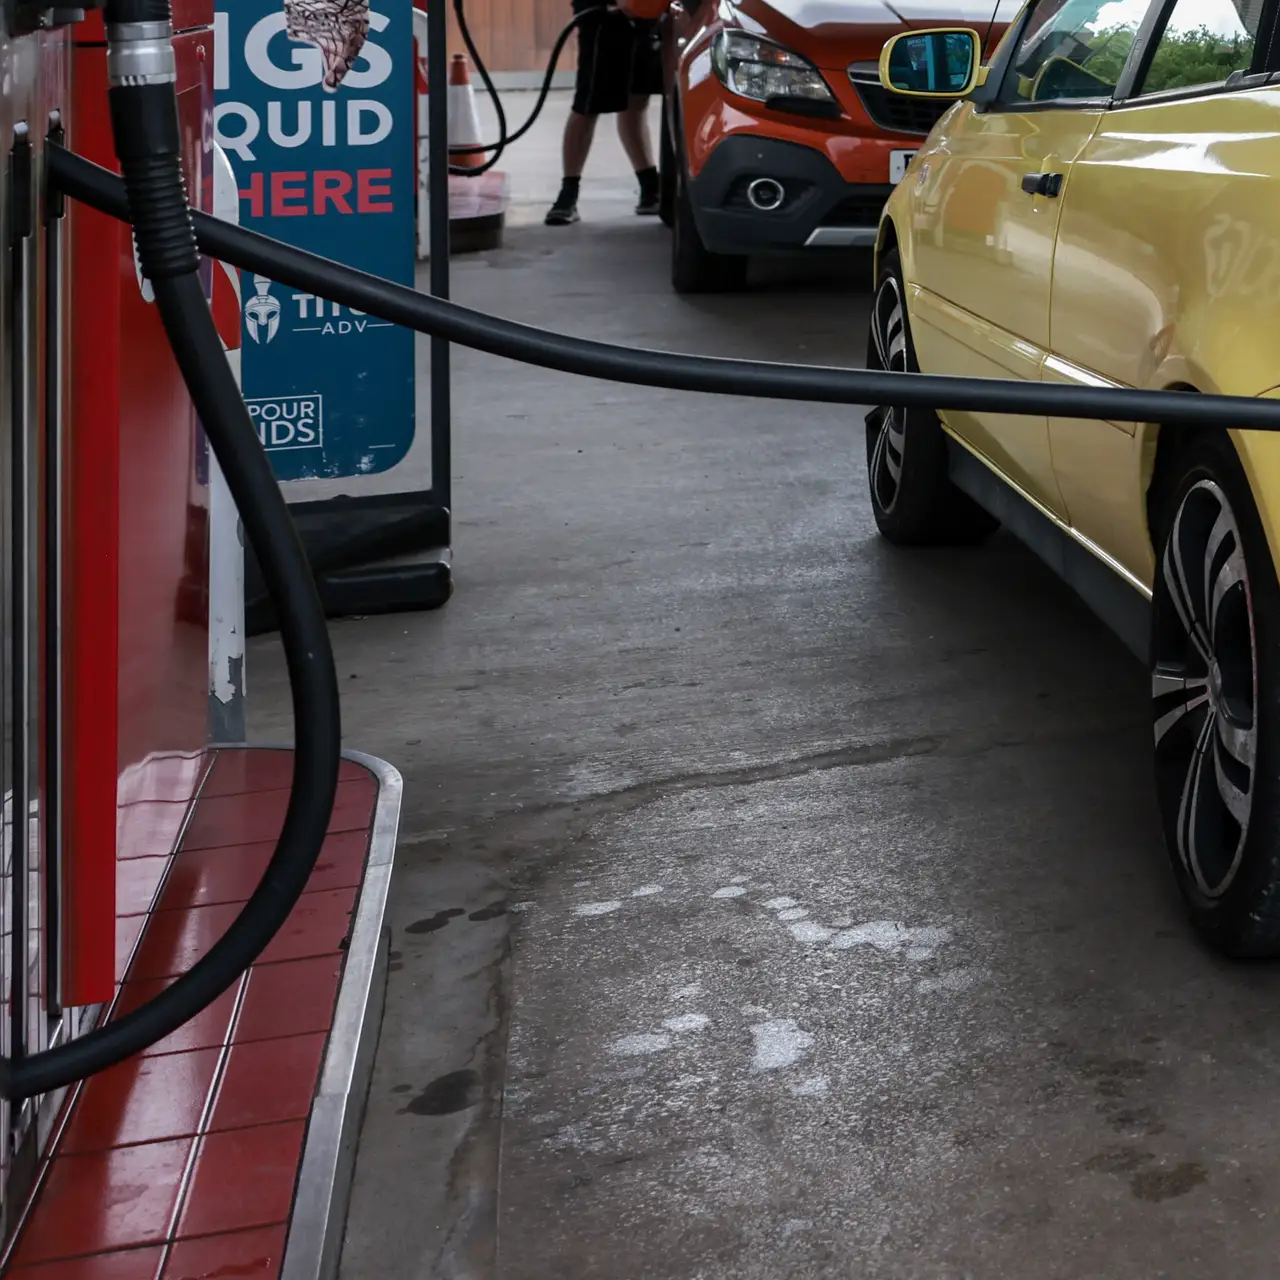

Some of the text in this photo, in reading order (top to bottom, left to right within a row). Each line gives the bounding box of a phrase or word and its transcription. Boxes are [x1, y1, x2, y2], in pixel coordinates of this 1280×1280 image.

[213, 99, 394, 162] QUID
[238, 167, 394, 218] HERE
[321, 320, 368, 335] ADV
